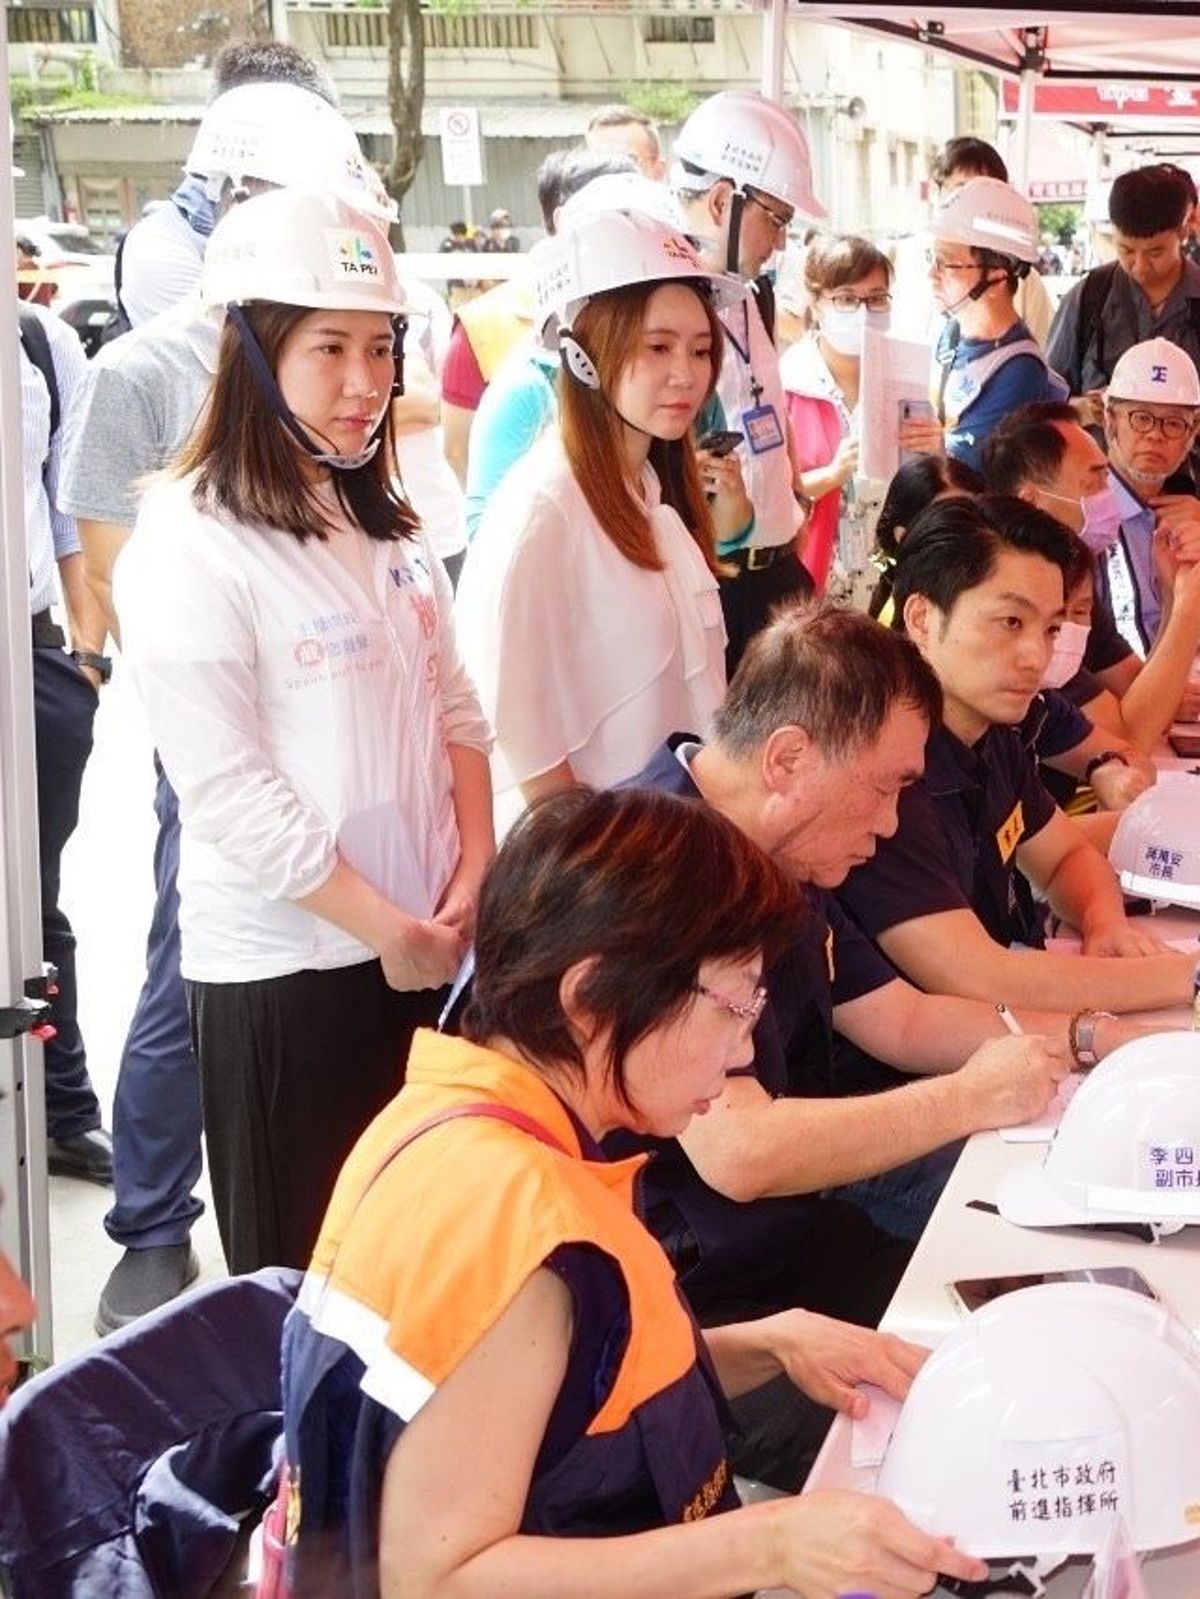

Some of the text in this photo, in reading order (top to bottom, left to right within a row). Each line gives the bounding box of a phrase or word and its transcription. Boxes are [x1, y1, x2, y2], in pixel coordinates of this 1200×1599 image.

[1006, 1460, 1117, 1493] 臺北市政府
[1008, 1490, 1119, 1521] 前進指揮所
